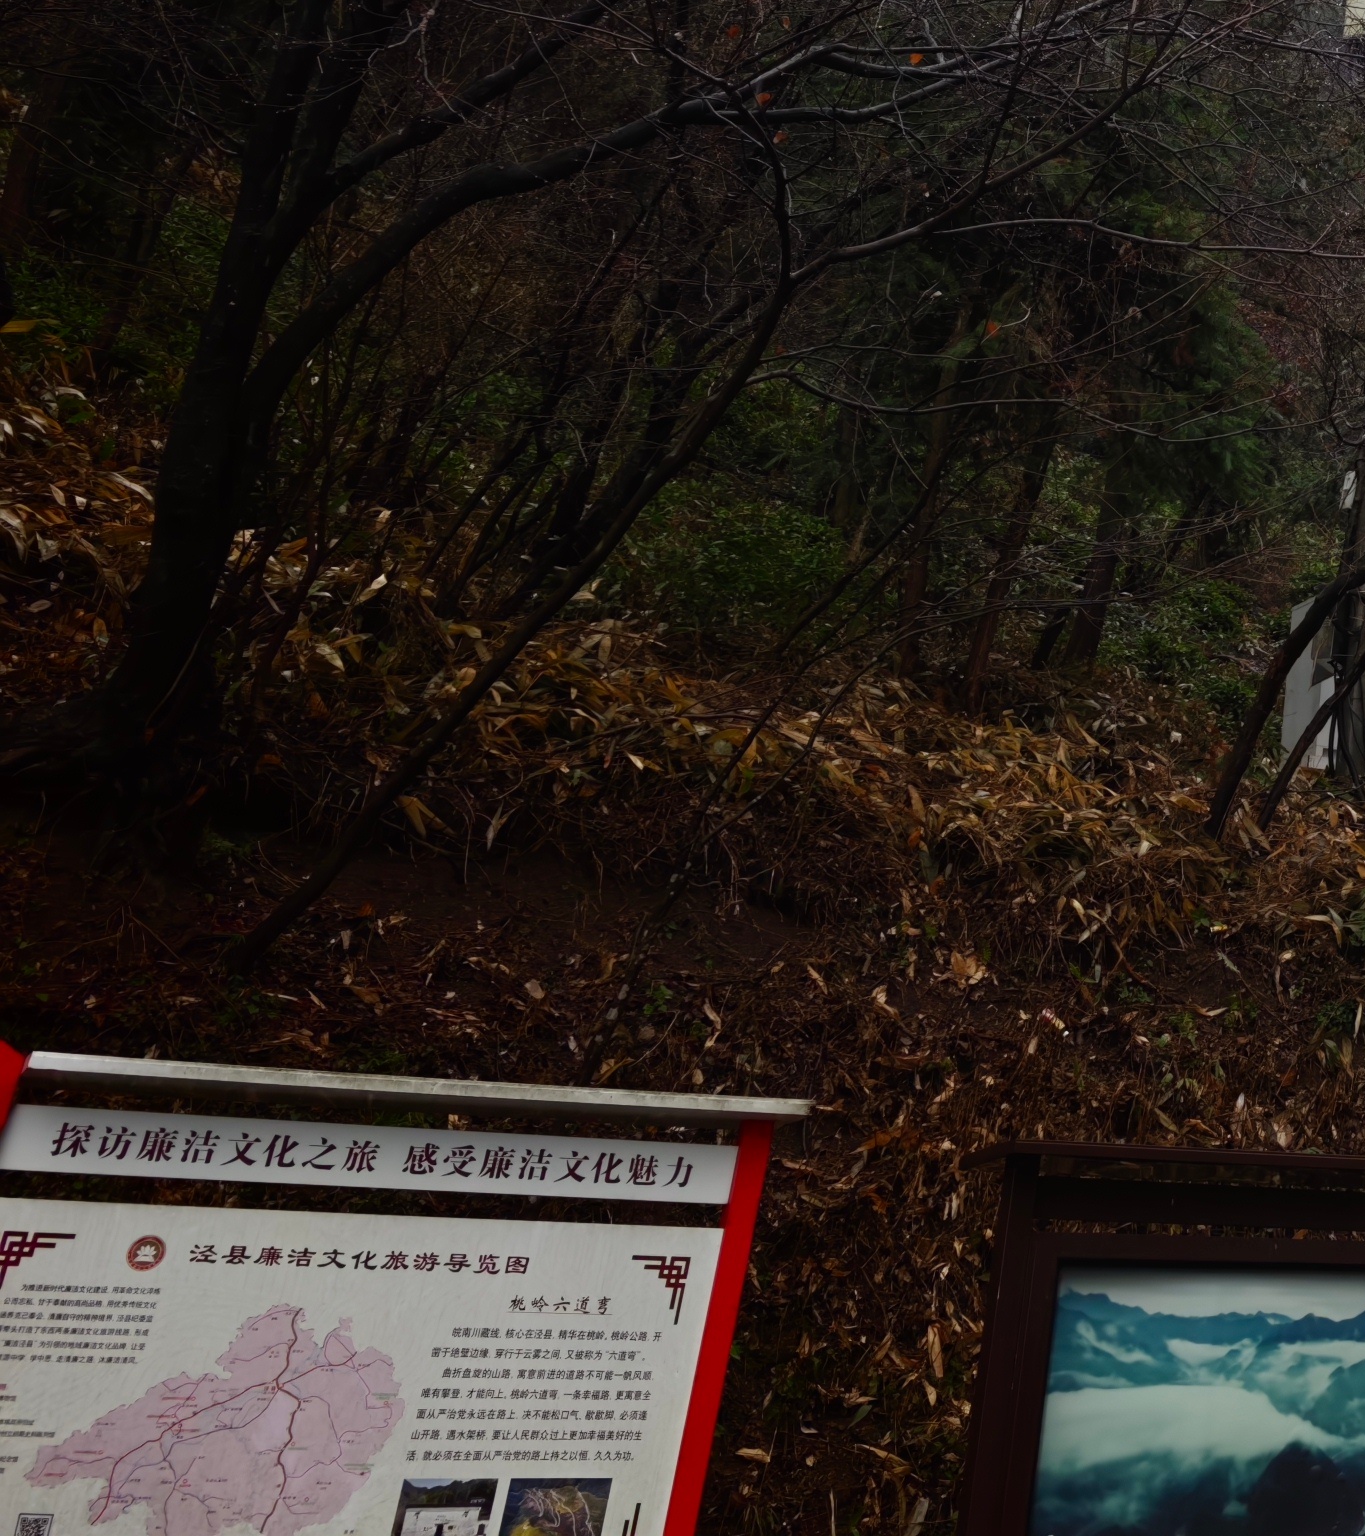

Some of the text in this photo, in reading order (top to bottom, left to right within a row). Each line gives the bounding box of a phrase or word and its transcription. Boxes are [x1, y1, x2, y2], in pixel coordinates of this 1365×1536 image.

[51, 1122, 695, 1188] 探访廉洁文化之旅 感受廉洁文化魅力
[189, 1244, 531, 1275] 泾县廉洁文化旅游导览图
[508, 1295, 612, 1315] 桃岭六道弯
